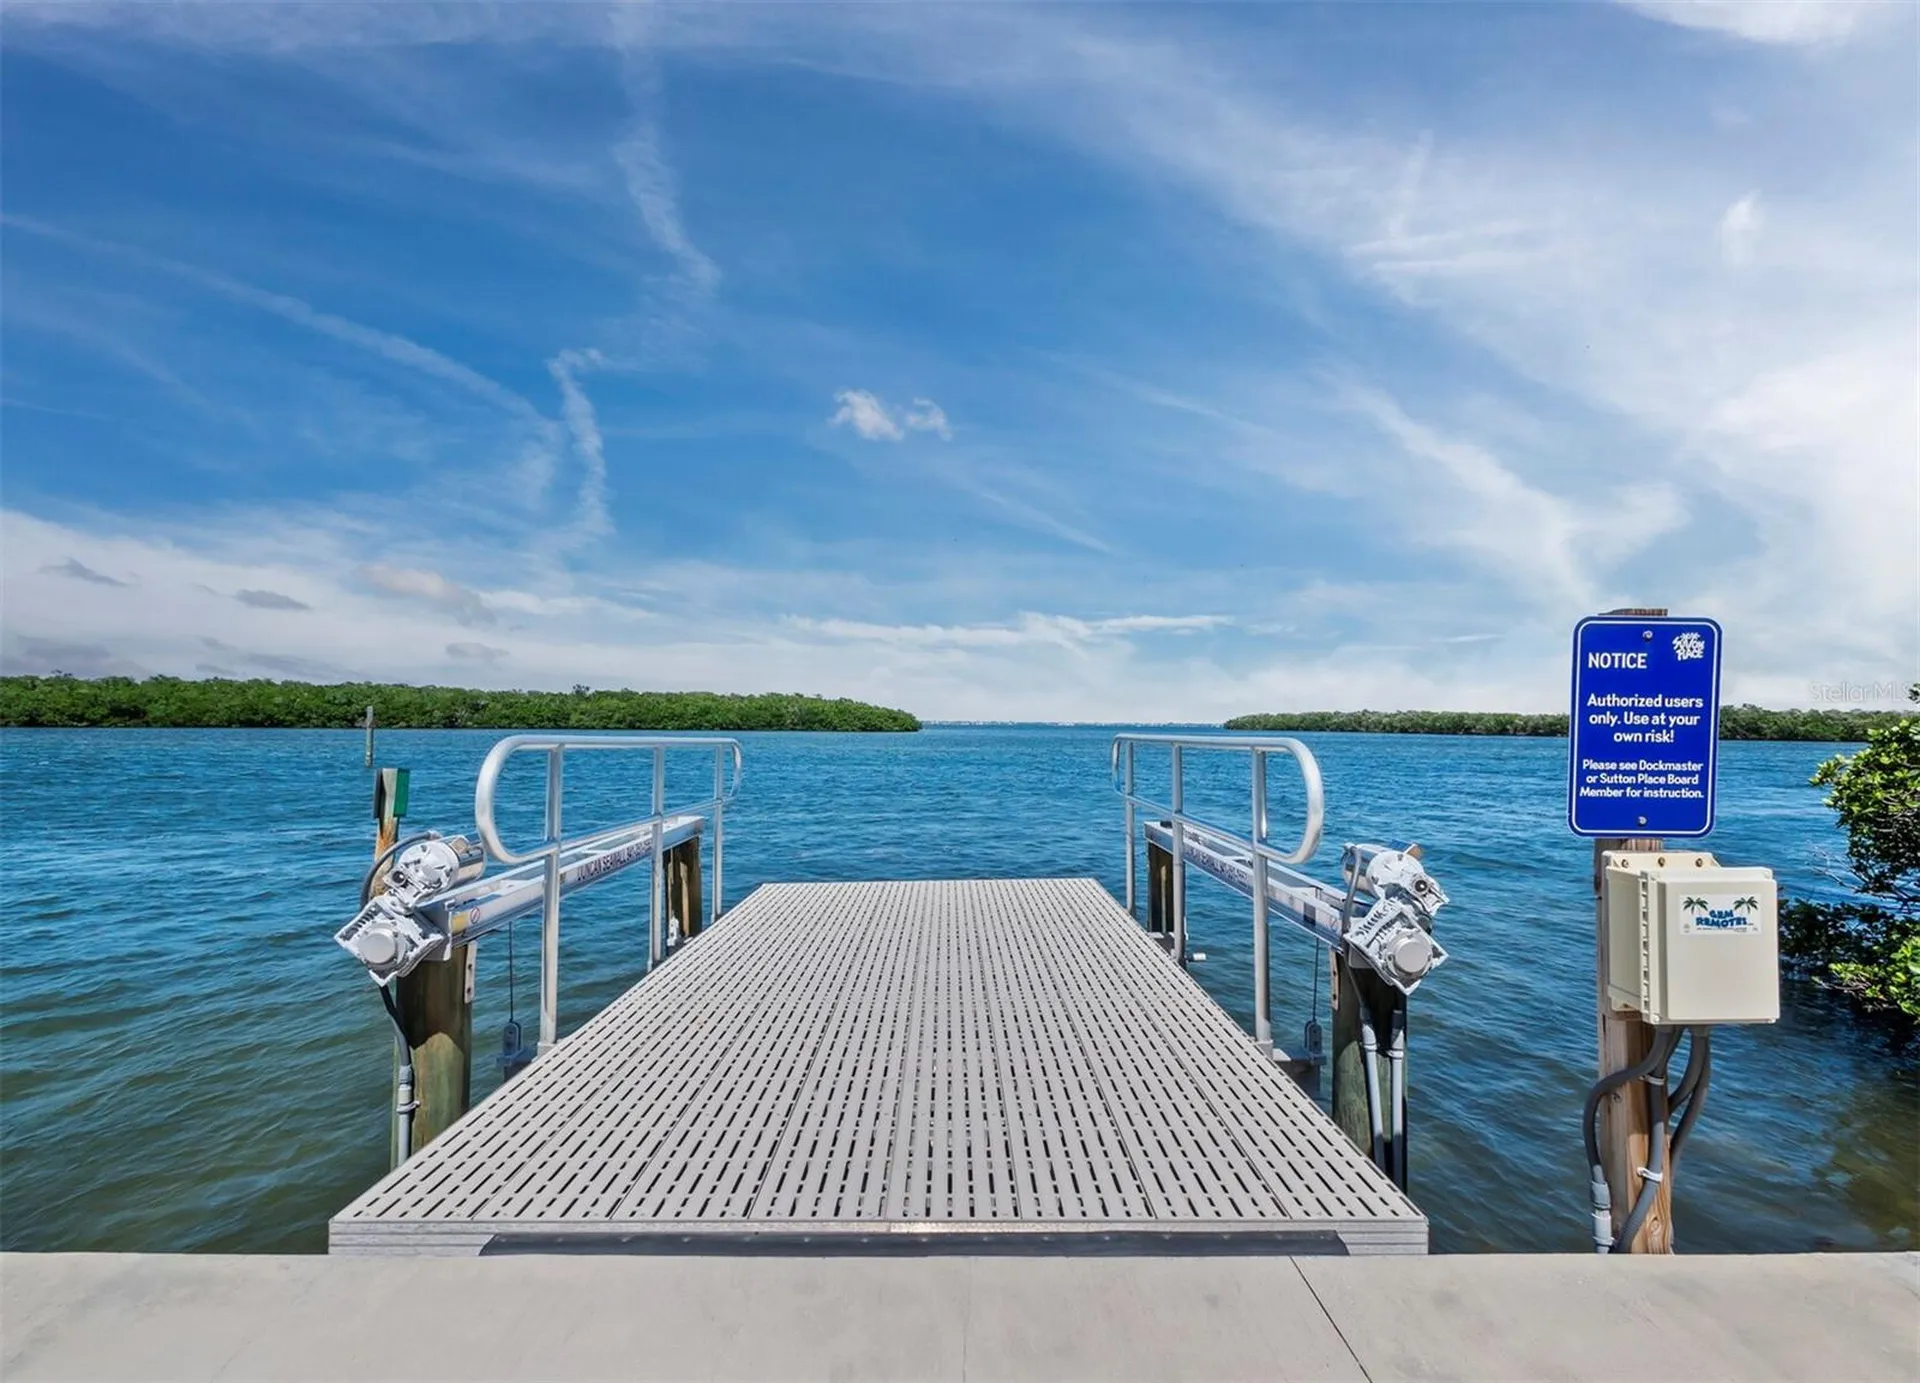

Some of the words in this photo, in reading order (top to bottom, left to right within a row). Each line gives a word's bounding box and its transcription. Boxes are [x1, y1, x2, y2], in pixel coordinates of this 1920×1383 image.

[1589, 653, 1647, 668] NOTICE
[1587, 694, 1662, 707] Authorized
[1665, 698, 1703, 708] users
[1589, 711, 1621, 727] only.
[1624, 712, 1649, 724] Use
[1651, 713, 1666, 725] at
[1669, 716, 1700, 727] your
[1614, 733, 1642, 742] own
[1645, 730, 1674, 742] risk!
[1583, 759, 1617, 770] Please
[1619, 762, 1637, 770] see
[1639, 760, 1703, 771] Dockmaster
[1600, 773, 1636, 783] Sutton
[1638, 773, 1666, 784] Place
[1667, 774, 1699, 784] Board
[1580, 787, 1624, 797] Member
[1626, 787, 1642, 797] for
[1644, 787, 1704, 798] instruction.
[1709, 909, 1735, 919] GEM
